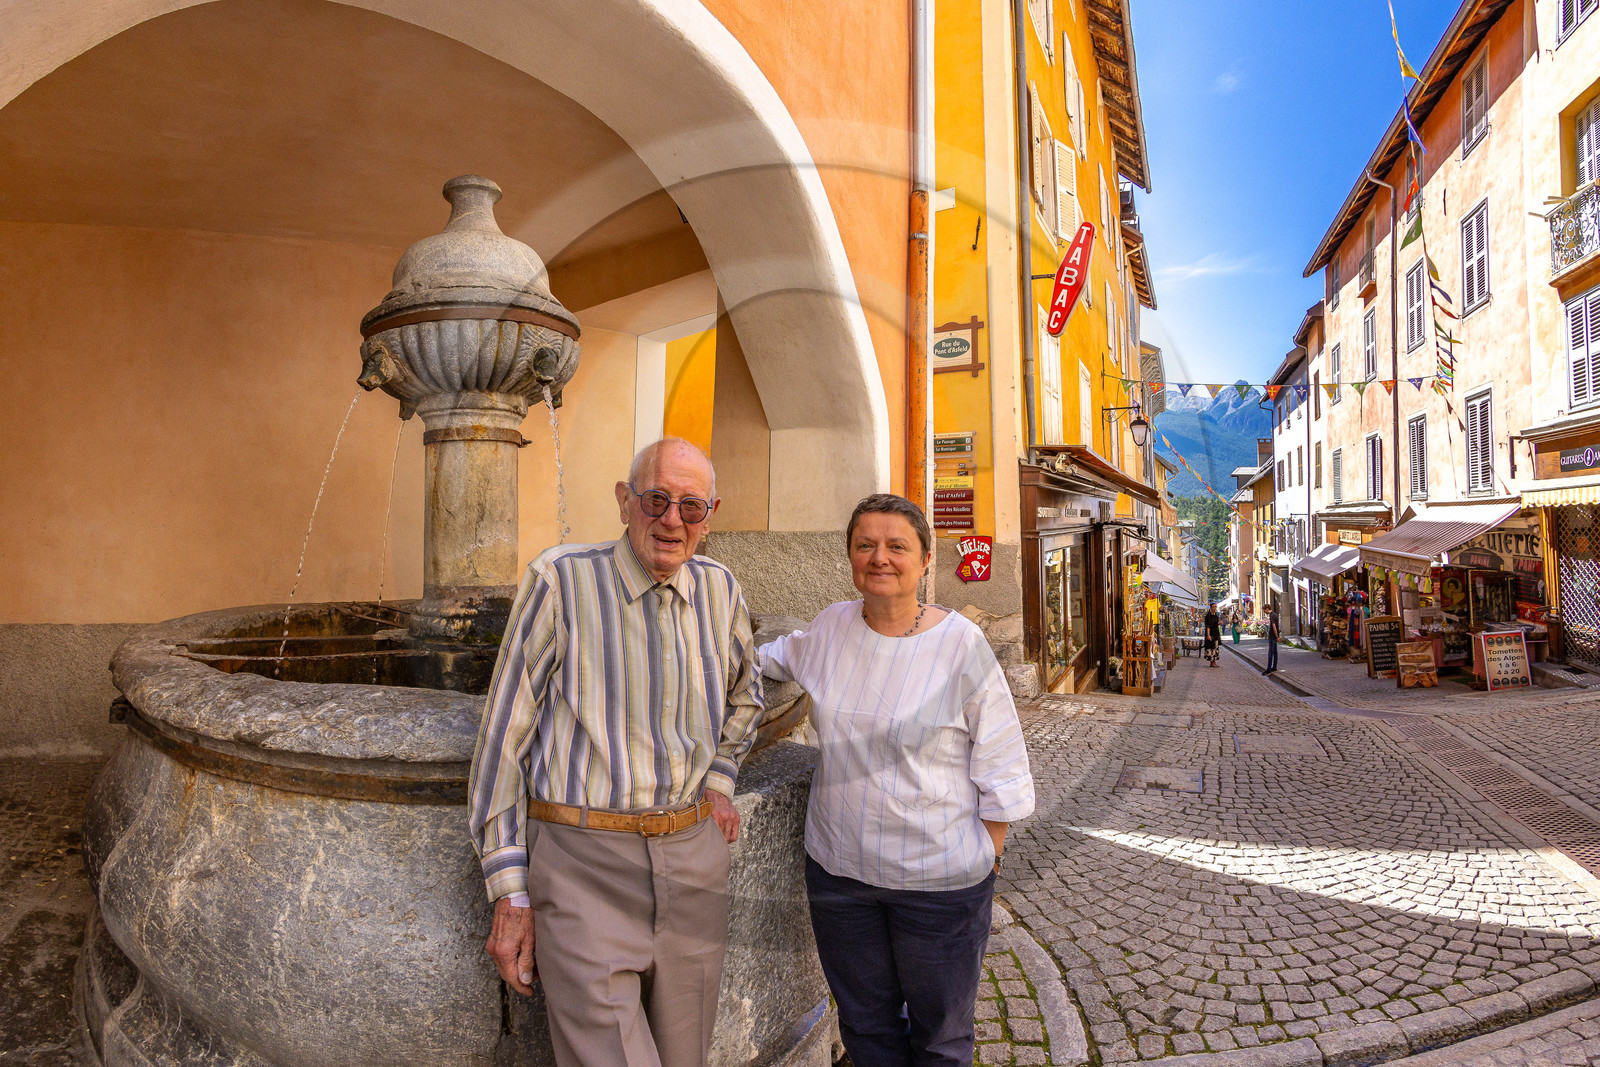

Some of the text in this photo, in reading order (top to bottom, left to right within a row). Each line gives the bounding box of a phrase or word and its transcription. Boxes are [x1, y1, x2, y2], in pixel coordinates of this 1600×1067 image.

[1049, 225, 1091, 329] TABAC
[947, 345, 968, 354] d'Asfeld
[1369, 623, 1390, 632] PANINI
[1503, 654, 1526, 662] Alpes
